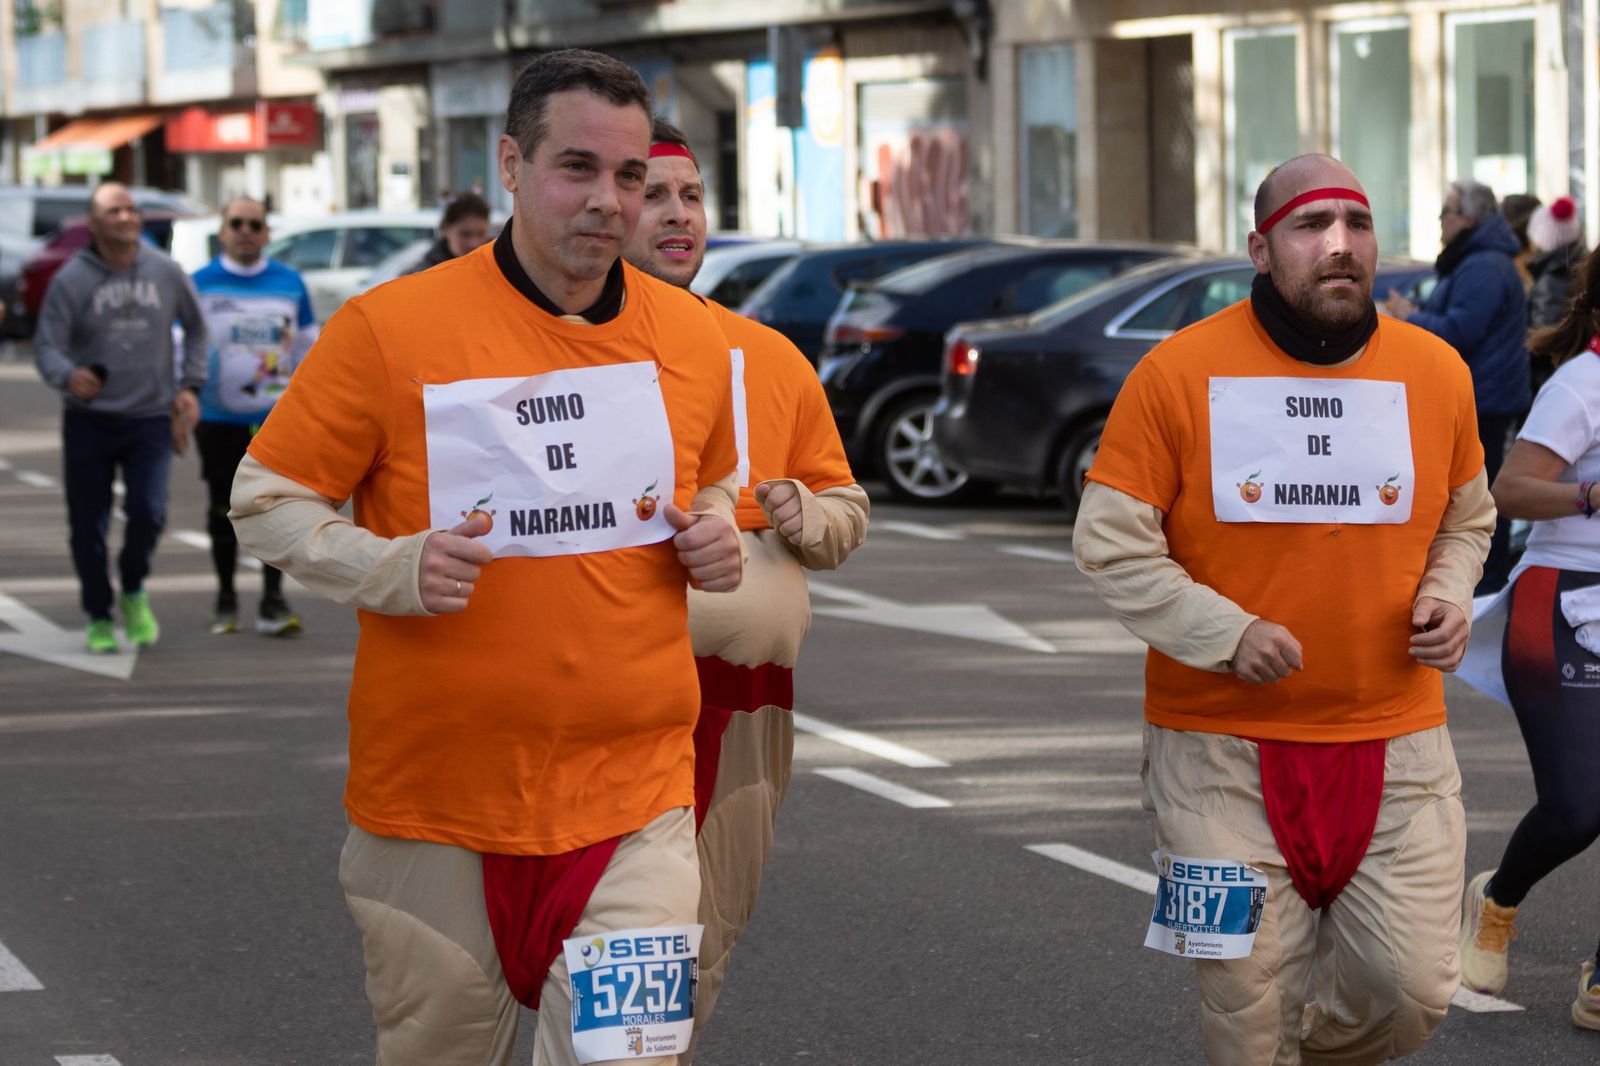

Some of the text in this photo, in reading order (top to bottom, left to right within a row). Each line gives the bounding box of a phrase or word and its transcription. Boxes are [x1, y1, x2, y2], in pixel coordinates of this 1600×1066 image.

[516, 393, 585, 425] SUMO
[1285, 396, 1343, 418] SUMO
[1307, 435, 1331, 456] DE
[546, 443, 577, 471] DE
[1274, 484, 1361, 506] NARANJA
[510, 502, 616, 536] NARANJA
[1172, 862, 1254, 882] SETEL
[1166, 882, 1229, 925] 3187
[609, 934, 691, 959] SETEL
[1187, 941, 1224, 950] Ayuntamiento
[1195, 948, 1222, 956] Salamanca
[592, 962, 682, 1018] 5252
[622, 1013, 665, 1025] MORALES
[646, 1045, 653, 1053] de
